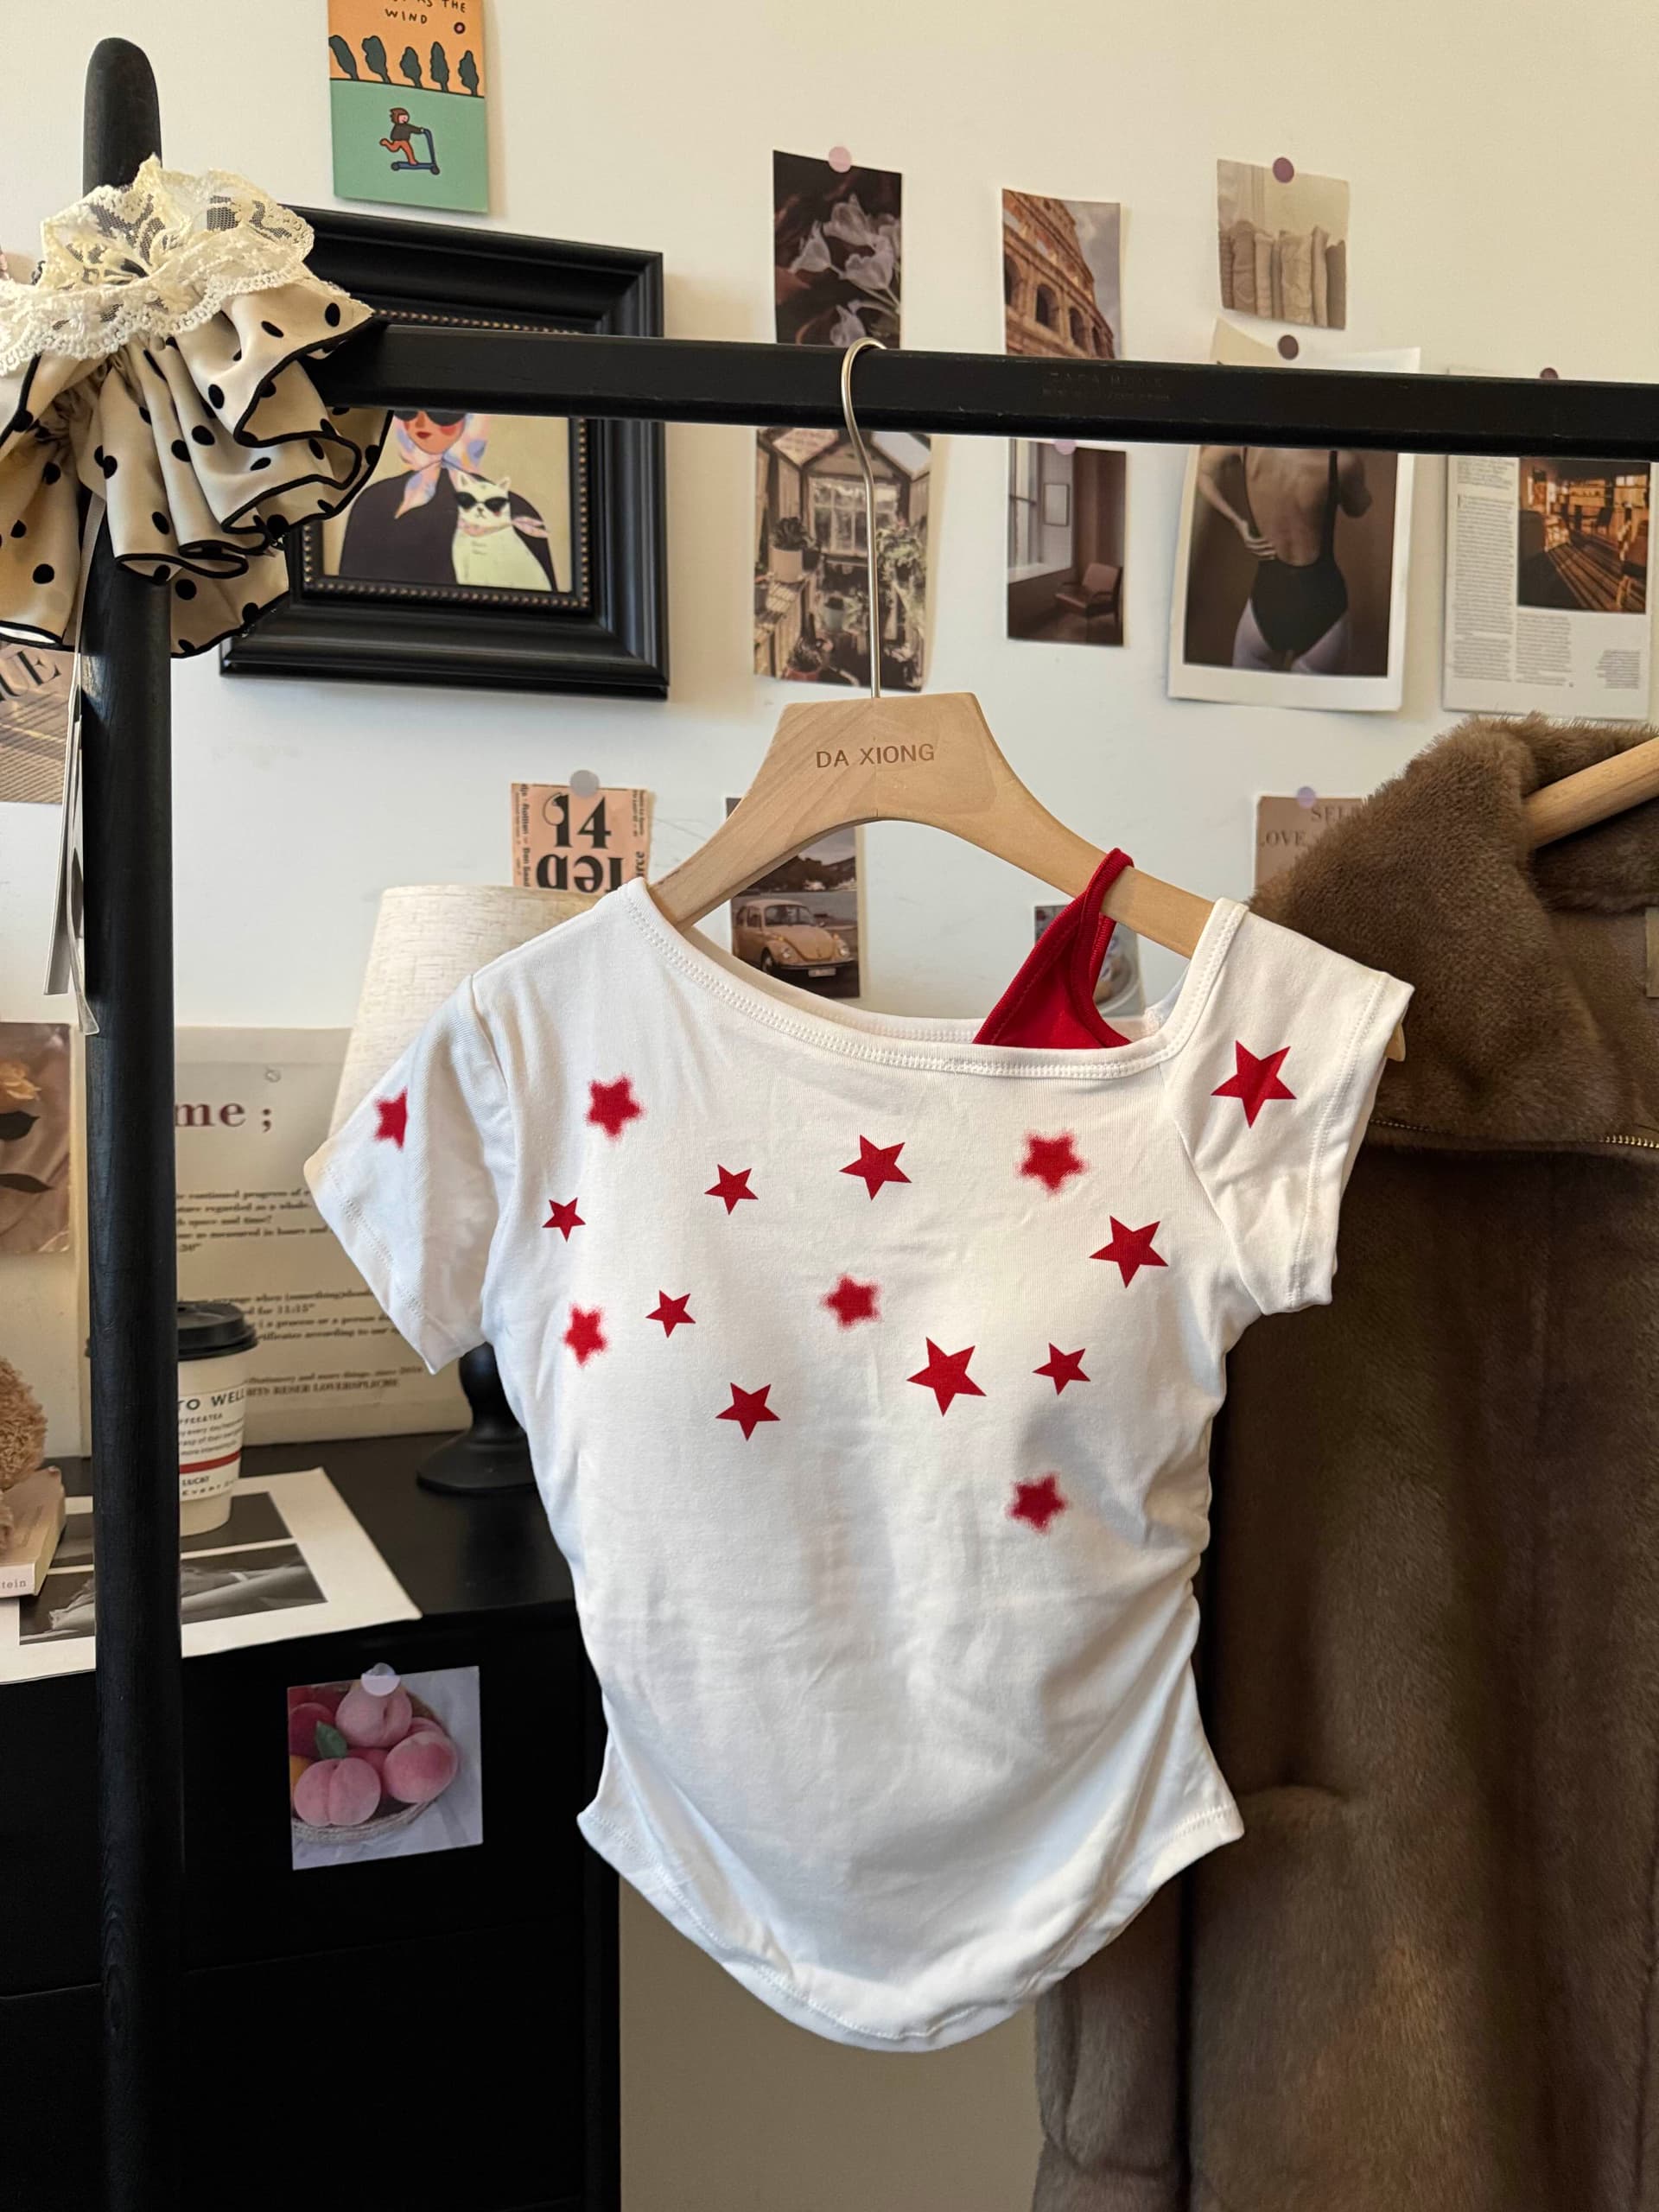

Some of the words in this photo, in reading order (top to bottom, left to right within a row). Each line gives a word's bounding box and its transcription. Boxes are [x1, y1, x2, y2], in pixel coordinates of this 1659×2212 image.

[442, 0, 466, 13] THE
[385, 9, 428, 24] WIND
[816, 749, 849, 768] DA
[859, 743, 935, 766] XIONG
